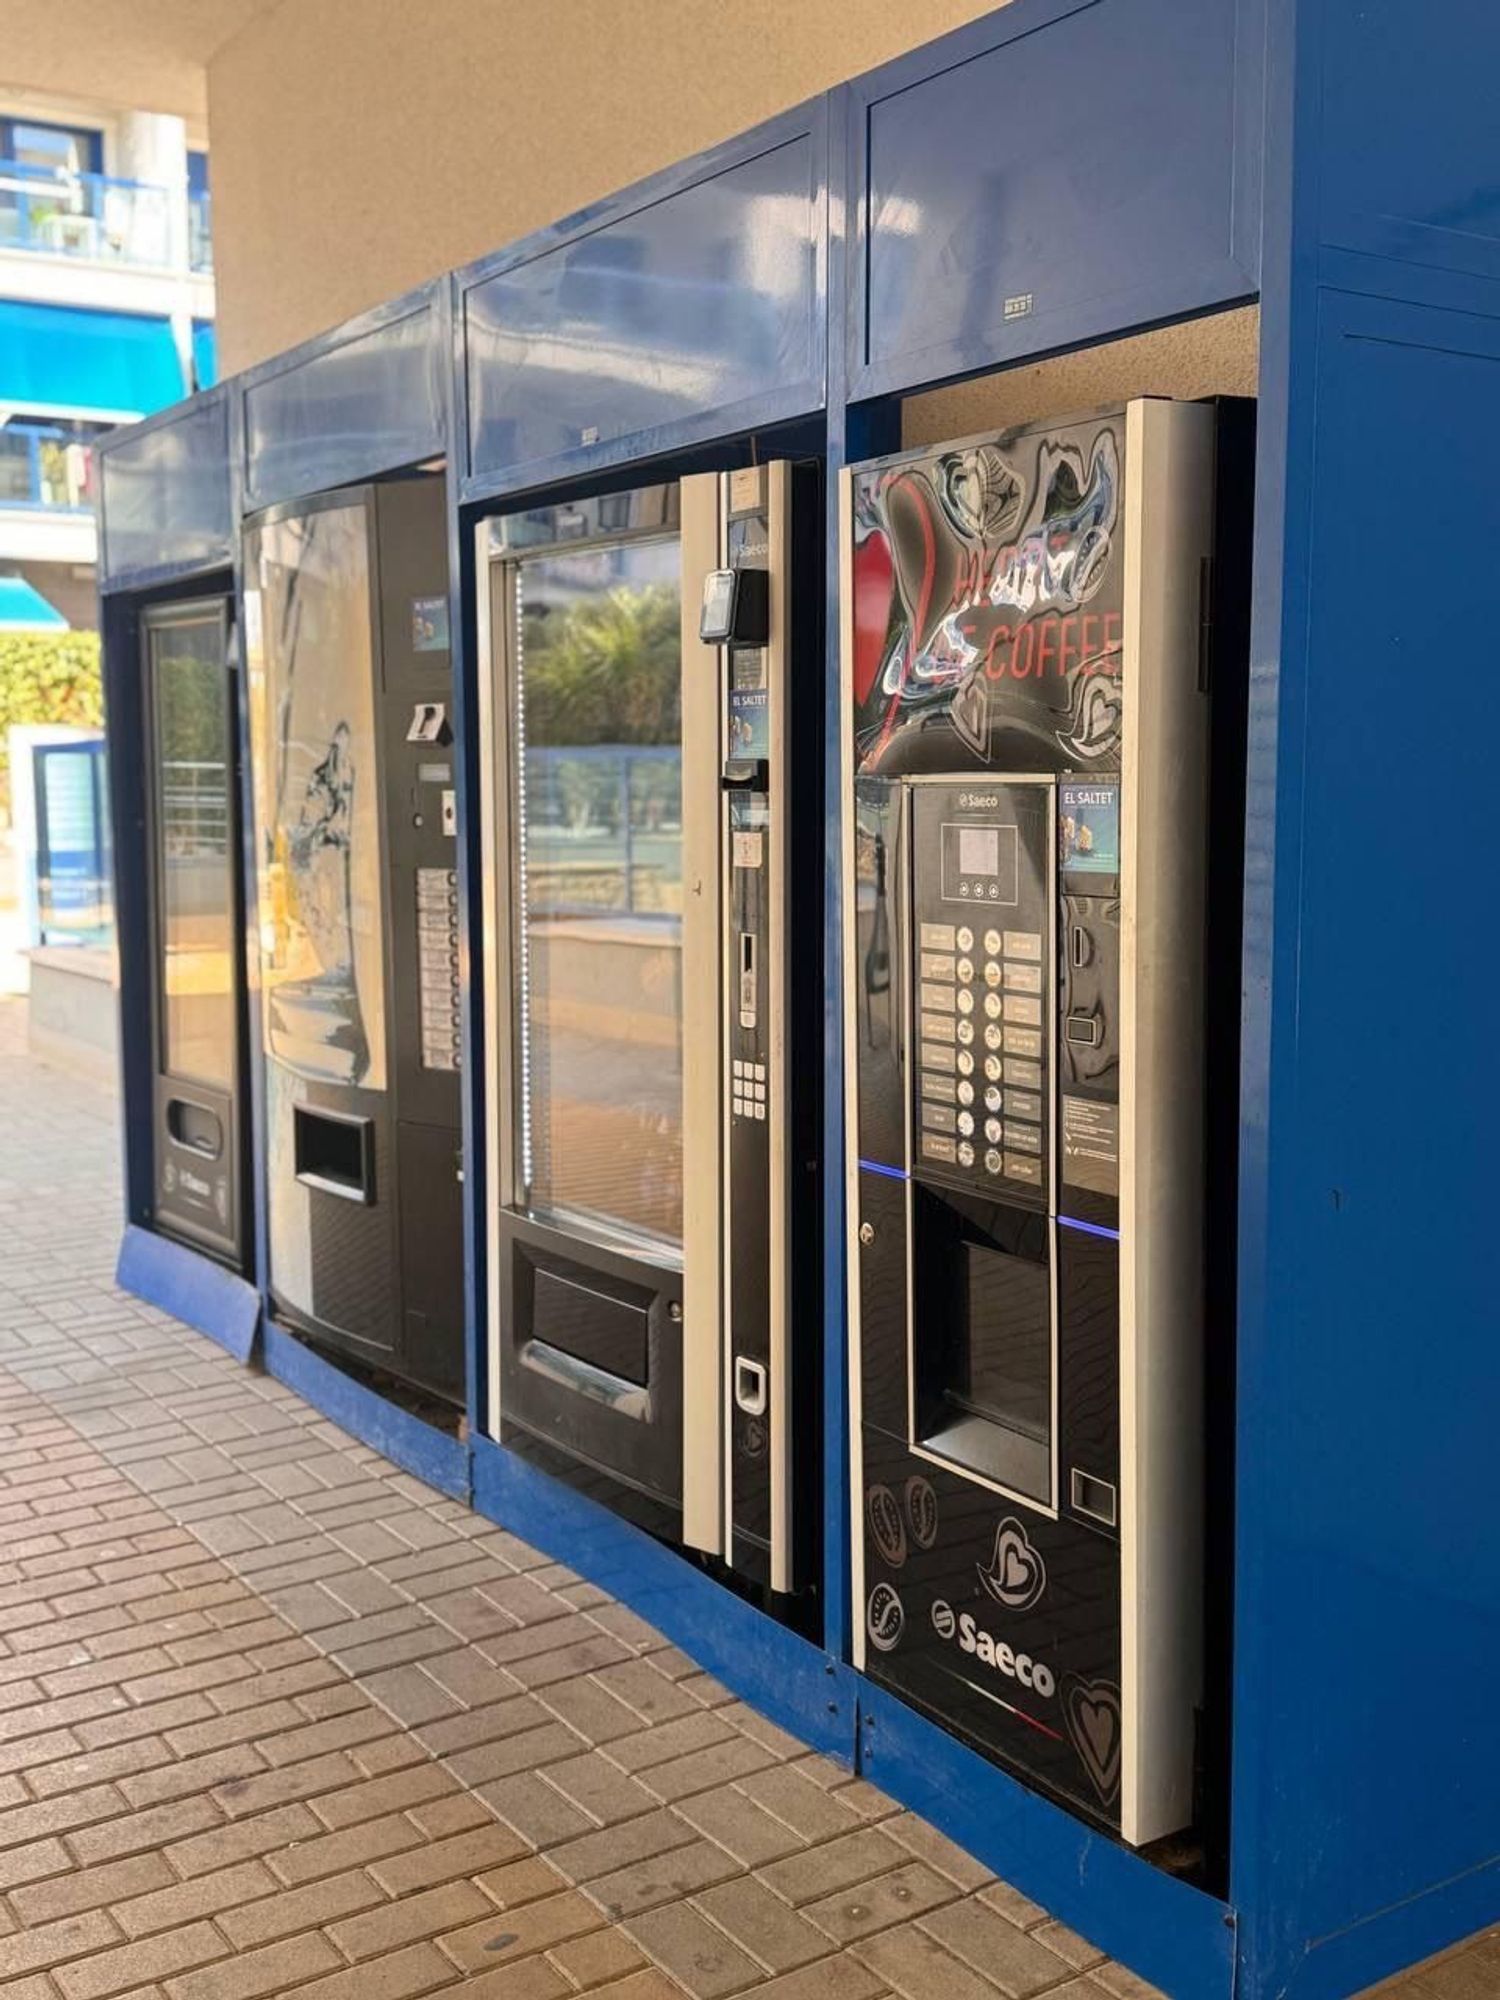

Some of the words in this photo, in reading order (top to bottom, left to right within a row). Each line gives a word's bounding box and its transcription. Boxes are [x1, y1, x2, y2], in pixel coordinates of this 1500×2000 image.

[985, 612, 1121, 680] COFFEE
[969, 794, 998, 807] Saeco
[1064, 791, 1075, 805] EL
[1077, 791, 1114, 805] SALTET
[959, 1612, 1055, 1698] Saeco
